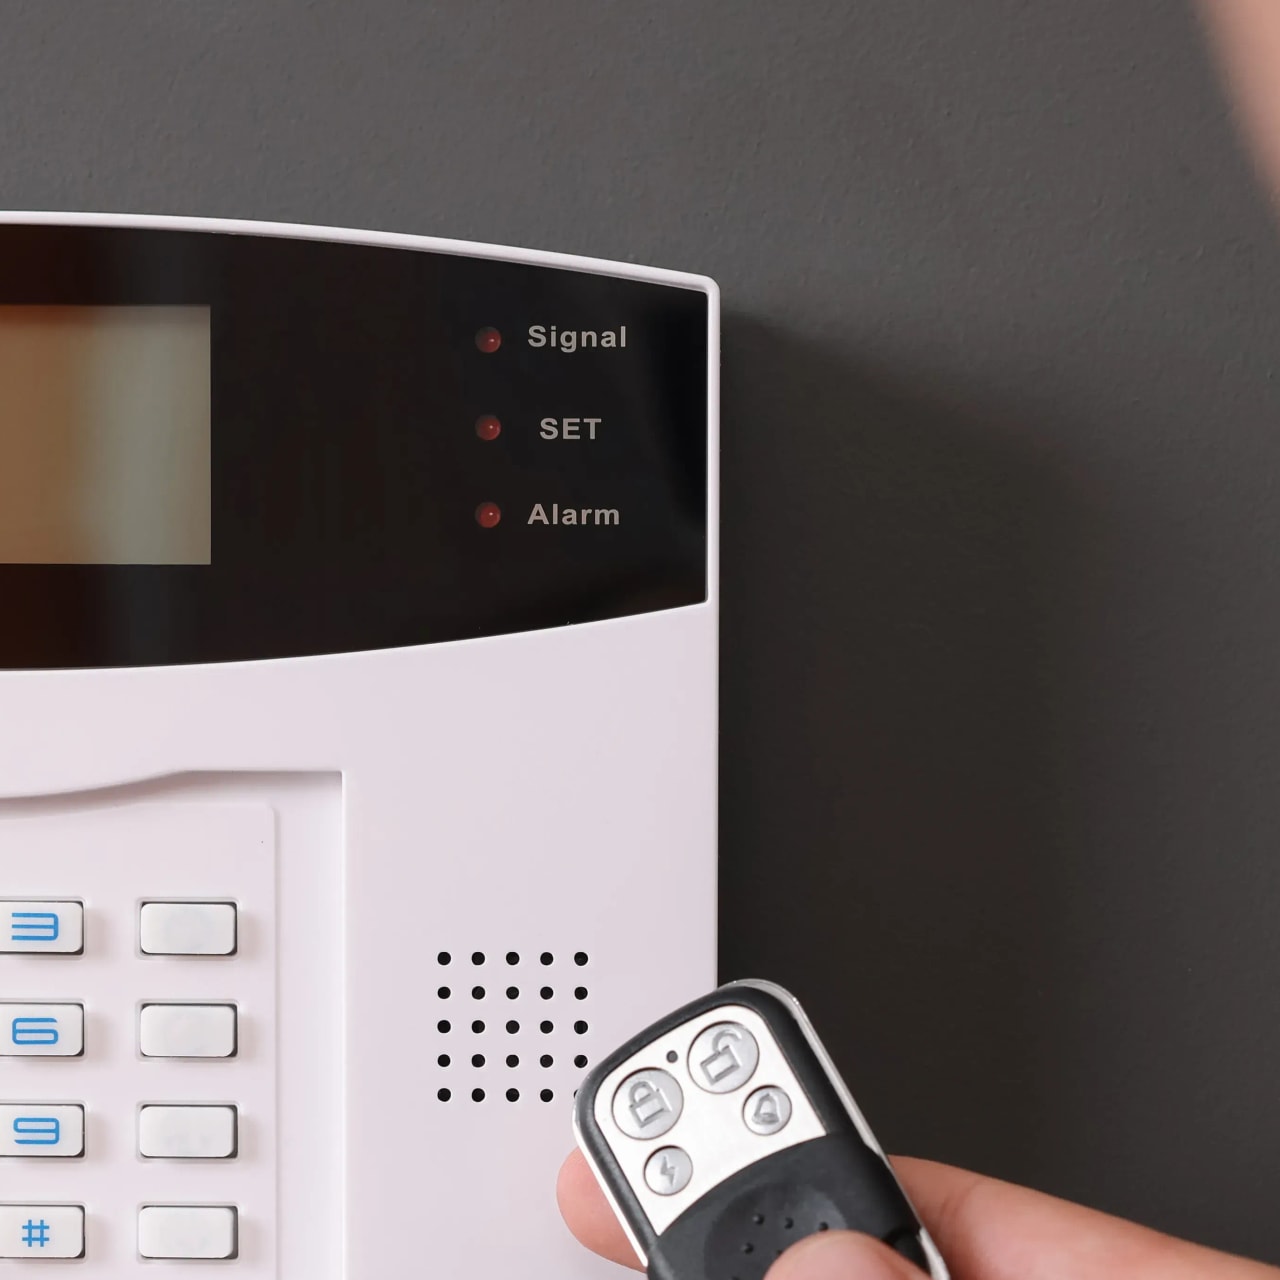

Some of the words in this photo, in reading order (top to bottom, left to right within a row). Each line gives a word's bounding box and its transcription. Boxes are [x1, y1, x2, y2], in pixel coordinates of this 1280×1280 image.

[527, 325, 627, 353] Signal
[539, 417, 602, 440] SET
[527, 503, 620, 526] Alarm
[11, 912, 60, 942] 3
[11, 1017, 59, 1046] 6
[13, 1116, 61, 1146] 9
